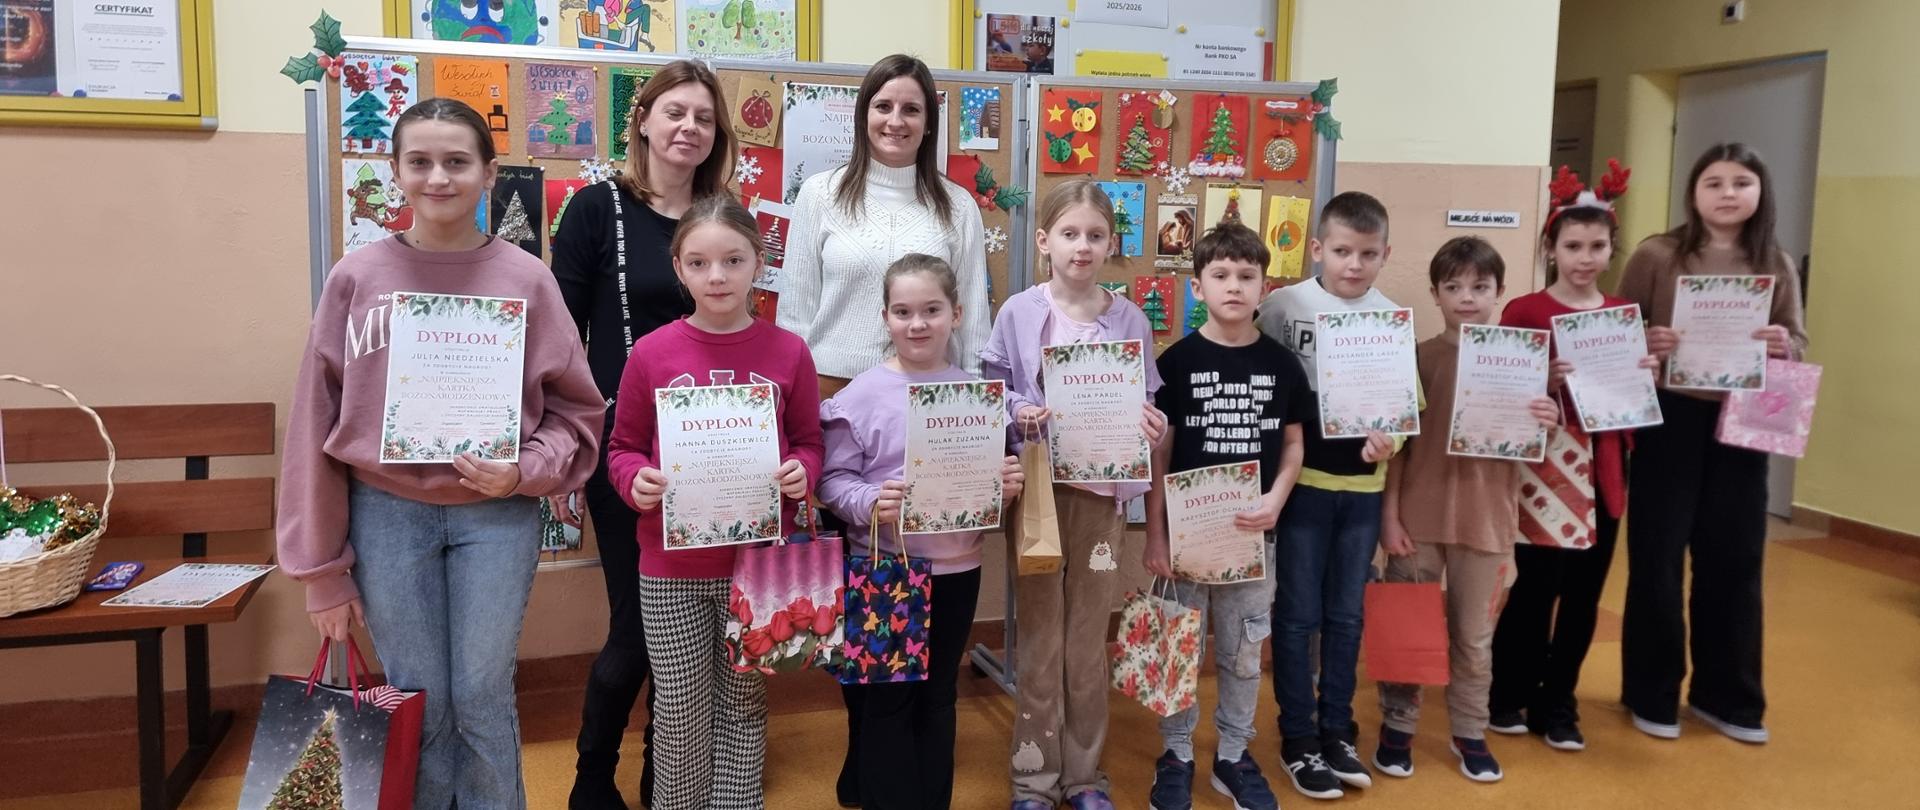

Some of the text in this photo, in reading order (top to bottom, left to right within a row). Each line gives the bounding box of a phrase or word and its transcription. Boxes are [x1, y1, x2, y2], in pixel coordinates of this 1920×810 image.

[94, 4, 154, 14] CERTYFIKAT
[1106, 2, 1143, 11] 2025/2026
[616, 220, 624, 238] NEVER
[617, 240, 625, 252] TOO
[618, 272, 626, 292] NEVER
[416, 330, 498, 346] DYPLOM
[1335, 335, 1393, 346] DYPLOM
[1574, 333, 1627, 350] DYPLOM
[444, 354, 509, 363] NIEDZIELSKA
[1477, 354, 1532, 368] DYPLOM
[1063, 373, 1124, 385] DYPLOM
[682, 417, 753, 432] DYPLOM
[927, 415, 987, 429] DYPLOM
[1216, 413, 1241, 424] YOUR
[675, 436, 770, 448] HANNA DUSZKIEWICZ
[956, 434, 991, 443] ZUZANNA
[1184, 490, 1242, 509] DYPLOM
